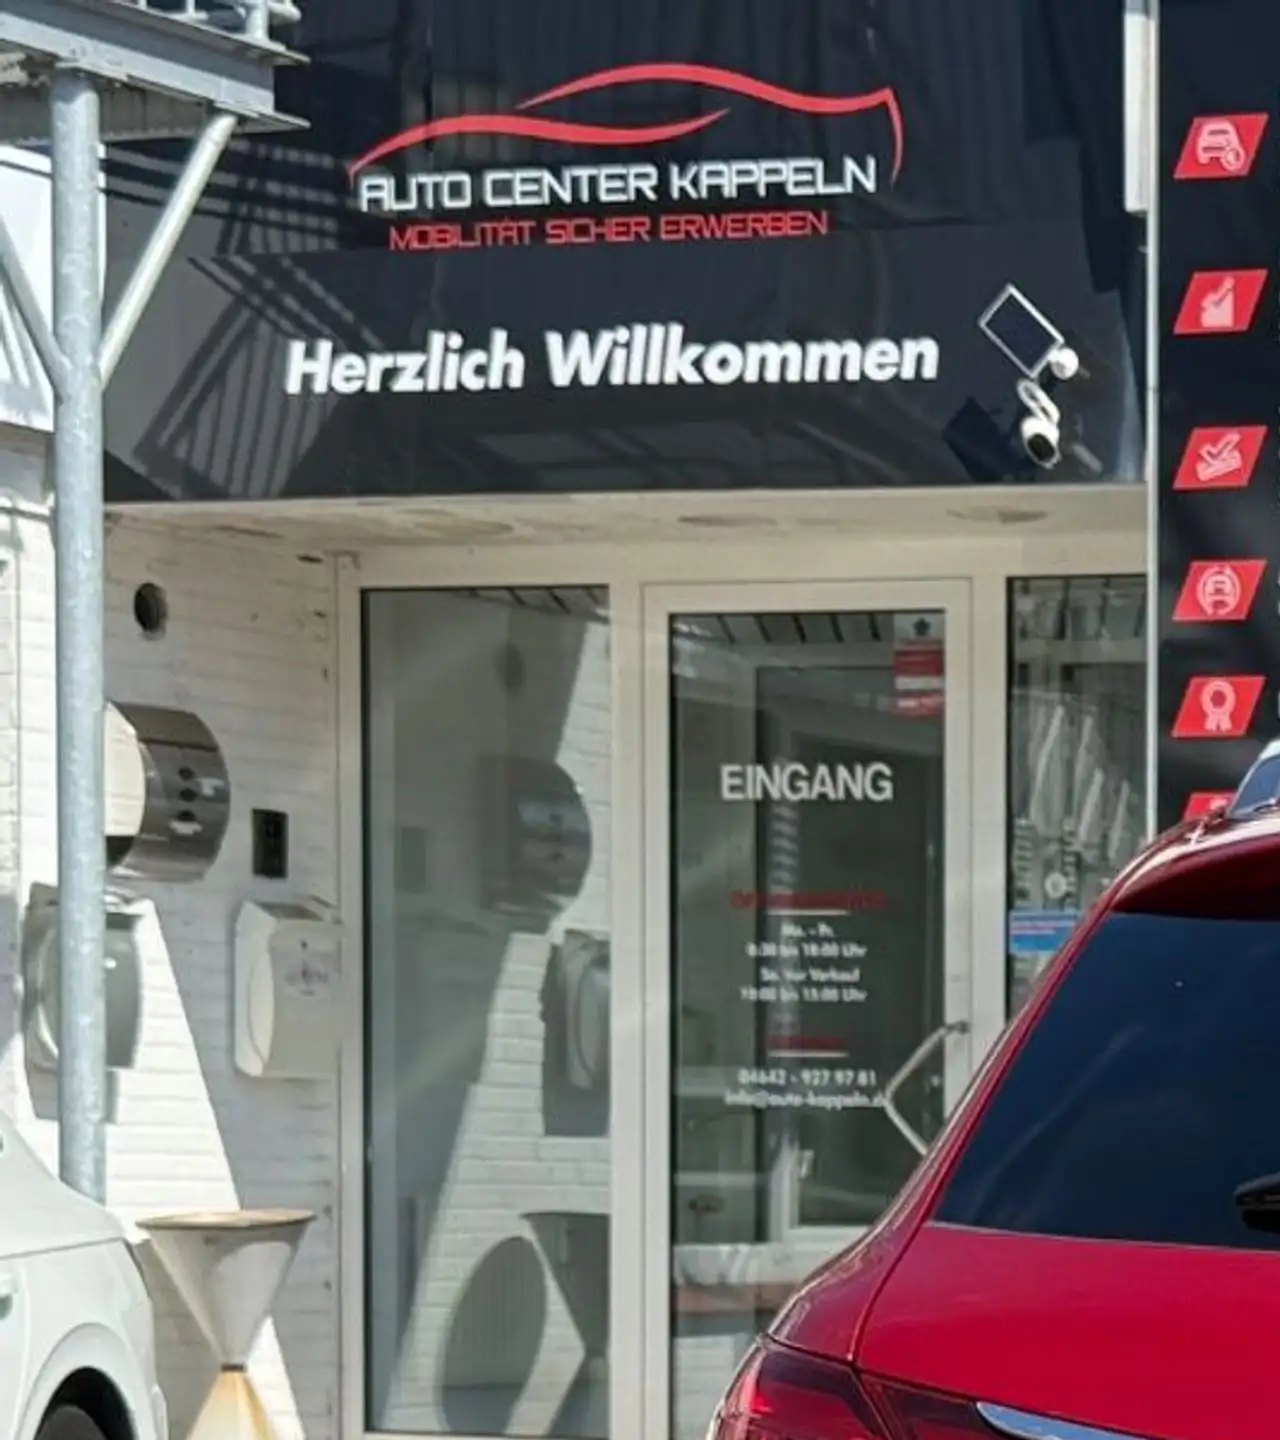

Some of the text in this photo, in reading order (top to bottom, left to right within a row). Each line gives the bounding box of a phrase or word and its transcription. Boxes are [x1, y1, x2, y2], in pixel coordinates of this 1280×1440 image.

[359, 154, 877, 212] AUTO CENTER KAPPELN
[545, 213, 651, 244] SICHER
[659, 209, 829, 241] ERWERBEN
[285, 321, 941, 397] Herzlich Willkommen
[720, 762, 895, 801] EINGANG
